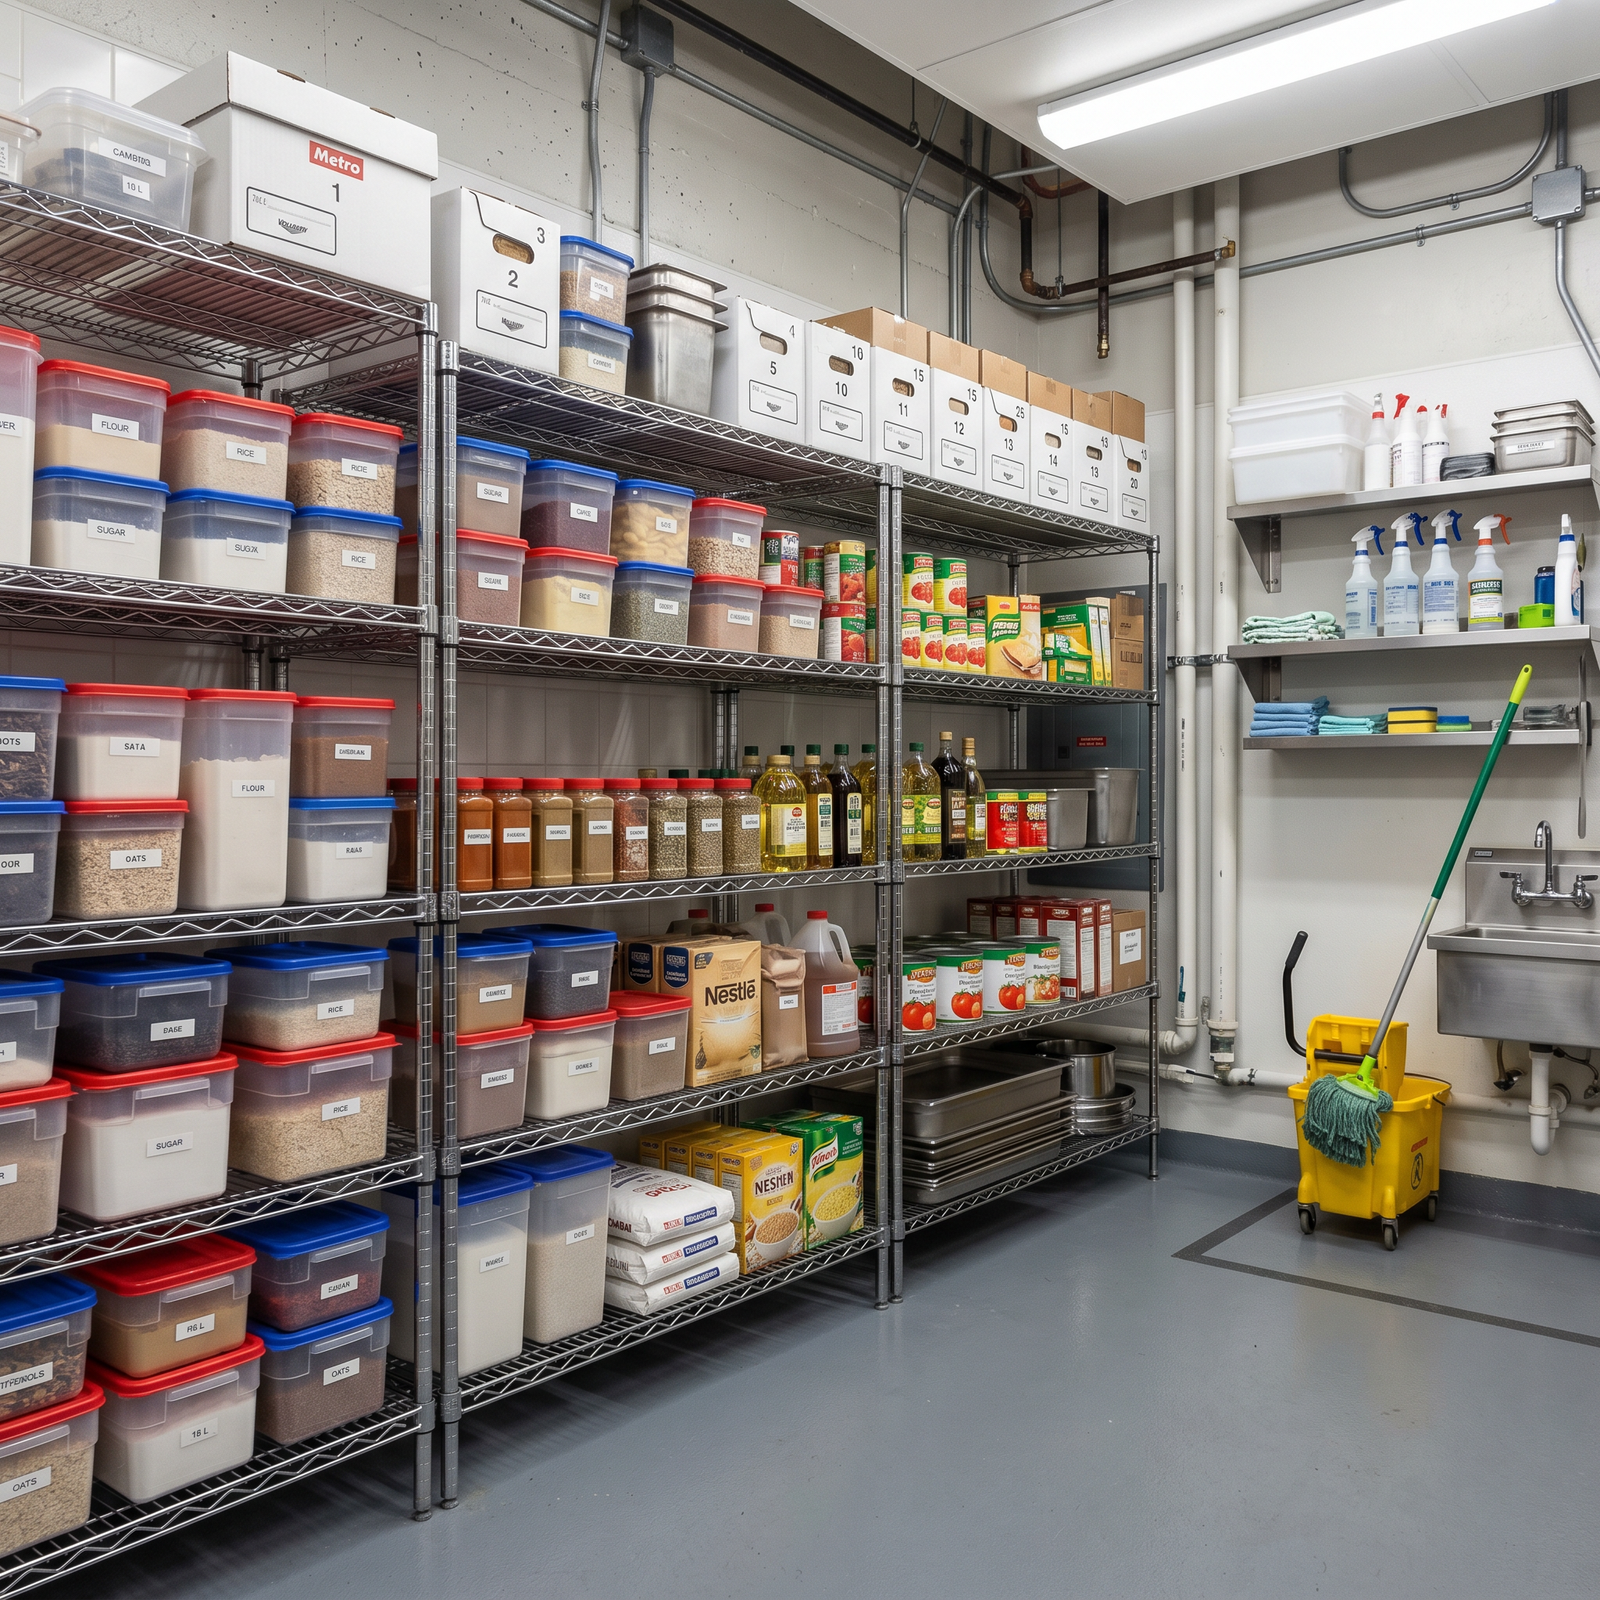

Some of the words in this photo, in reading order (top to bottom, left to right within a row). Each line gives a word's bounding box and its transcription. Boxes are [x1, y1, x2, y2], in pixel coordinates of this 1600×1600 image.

[313, 147, 361, 175] Metro
[138, 185, 143, 193] L
[332, 183, 339, 202] 1
[537, 227, 545, 244] 3
[508, 270, 518, 288] 2
[770, 361, 776, 375] 5
[914, 368, 924, 382] 15
[836, 382, 847, 396] 10
[968, 388, 977, 402] 15
[899, 403, 907, 417] 11
[1016, 406, 1025, 419] 25
[101, 421, 129, 433] FLOUR
[954, 421, 964, 435] 12
[1061, 424, 1069, 435] 15
[1005, 438, 1013, 451] 13
[237, 447, 255, 458] RICE
[1050, 454, 1057, 466] 14
[1091, 466, 1098, 478] 13
[1131, 478, 1138, 489] 20
[97, 525, 126, 537] SUGAR
[351, 555, 366, 563] RICE
[333, 1104, 349, 1114] RICE
[156, 1139, 183, 1150] SUGAR
[203, 1427, 209, 1436] L
[12, 1477, 37, 1491] OATS
